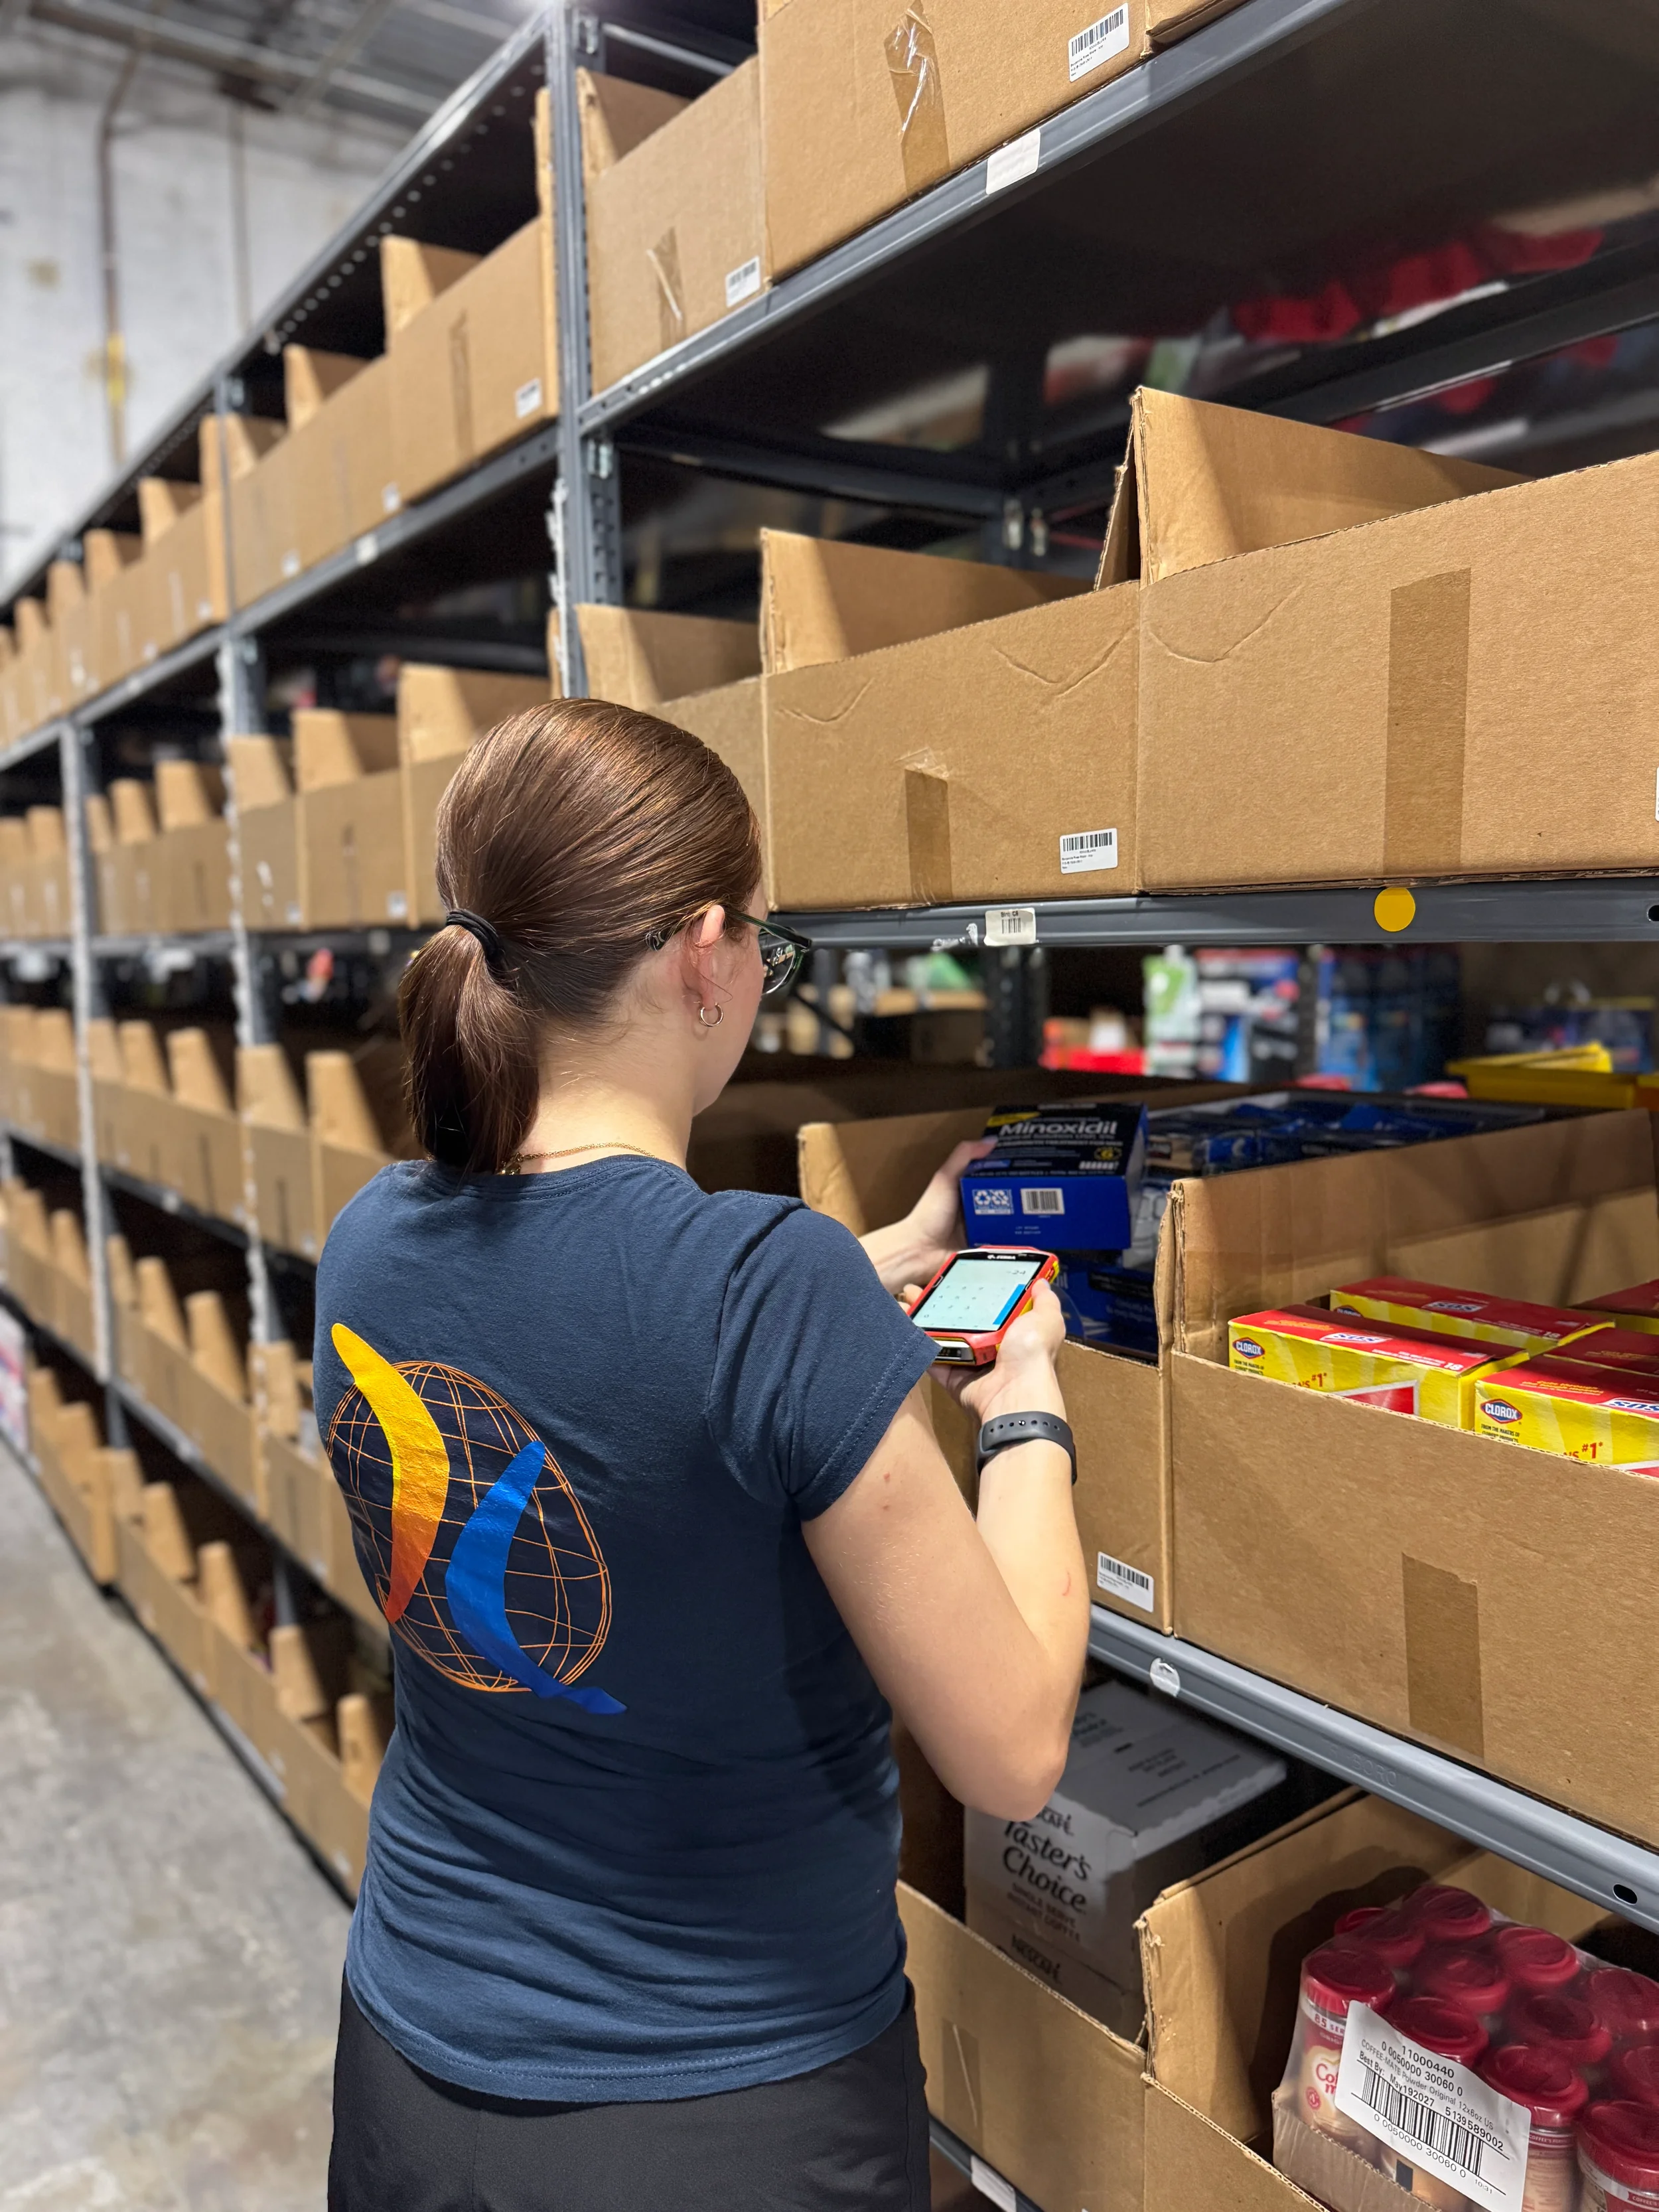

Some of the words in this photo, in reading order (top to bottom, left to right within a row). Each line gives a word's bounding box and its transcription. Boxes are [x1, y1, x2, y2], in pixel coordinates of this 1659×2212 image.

[999, 1120, 1118, 1136] Minoxidil
[1236, 1341, 1262, 1355] CLOROX
[1484, 1403, 1518, 1420] CLOROX
[1004, 1820, 1092, 1882] Taster's
[1003, 1845, 1086, 1913] Choice
[1315, 2013, 1327, 2028] 85
[1359, 2051, 1374, 2069] Best
[1374, 2059, 1385, 2077] By:
[1382, 2041, 1387, 2051] 0
[1388, 2046, 1422, 2077] 0050000
[1425, 2071, 1455, 2093] 30060
[1457, 2087, 1463, 2097] 0
[1402, 2045, 1455, 2079] 11000440
[1361, 2039, 1402, 2076] COFFEE-MATE
[1402, 2069, 1427, 2091] Powder
[1429, 2087, 1457, 2106] Original
[1484, 2117, 1494, 2131] US
[1374, 2113, 1380, 2122] 0
[1382, 2119, 1423, 2151] 0050000
[1425, 2148, 1457, 2173] 30060
[1460, 2168, 1466, 2178] 0
